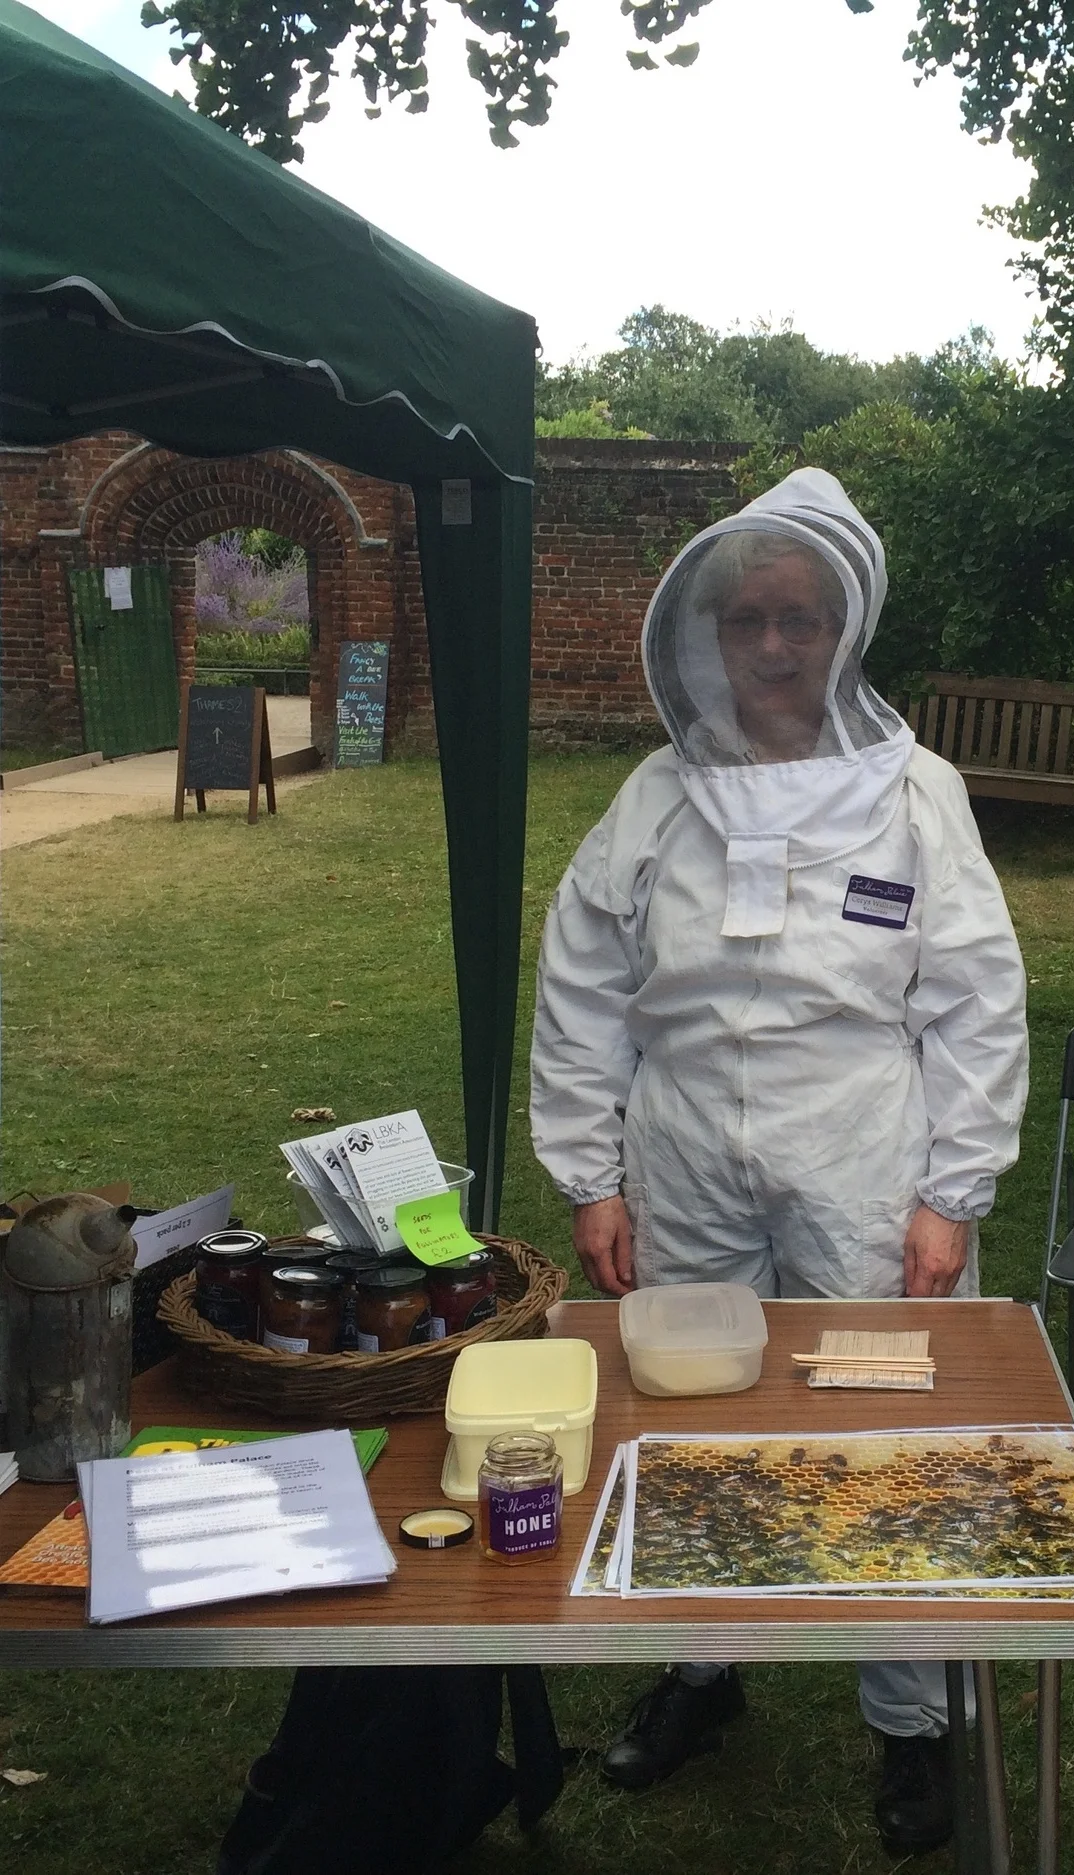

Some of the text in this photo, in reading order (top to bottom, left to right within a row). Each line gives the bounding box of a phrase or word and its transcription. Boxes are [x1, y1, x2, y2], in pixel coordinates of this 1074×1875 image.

[344, 690, 369, 701] Walk
[372, 1121, 408, 1140] LBKA
[431, 1247, 452, 1258] £2
[230, 1454, 272, 1463] Palace
[492, 1496, 537, 1513] Fulham
